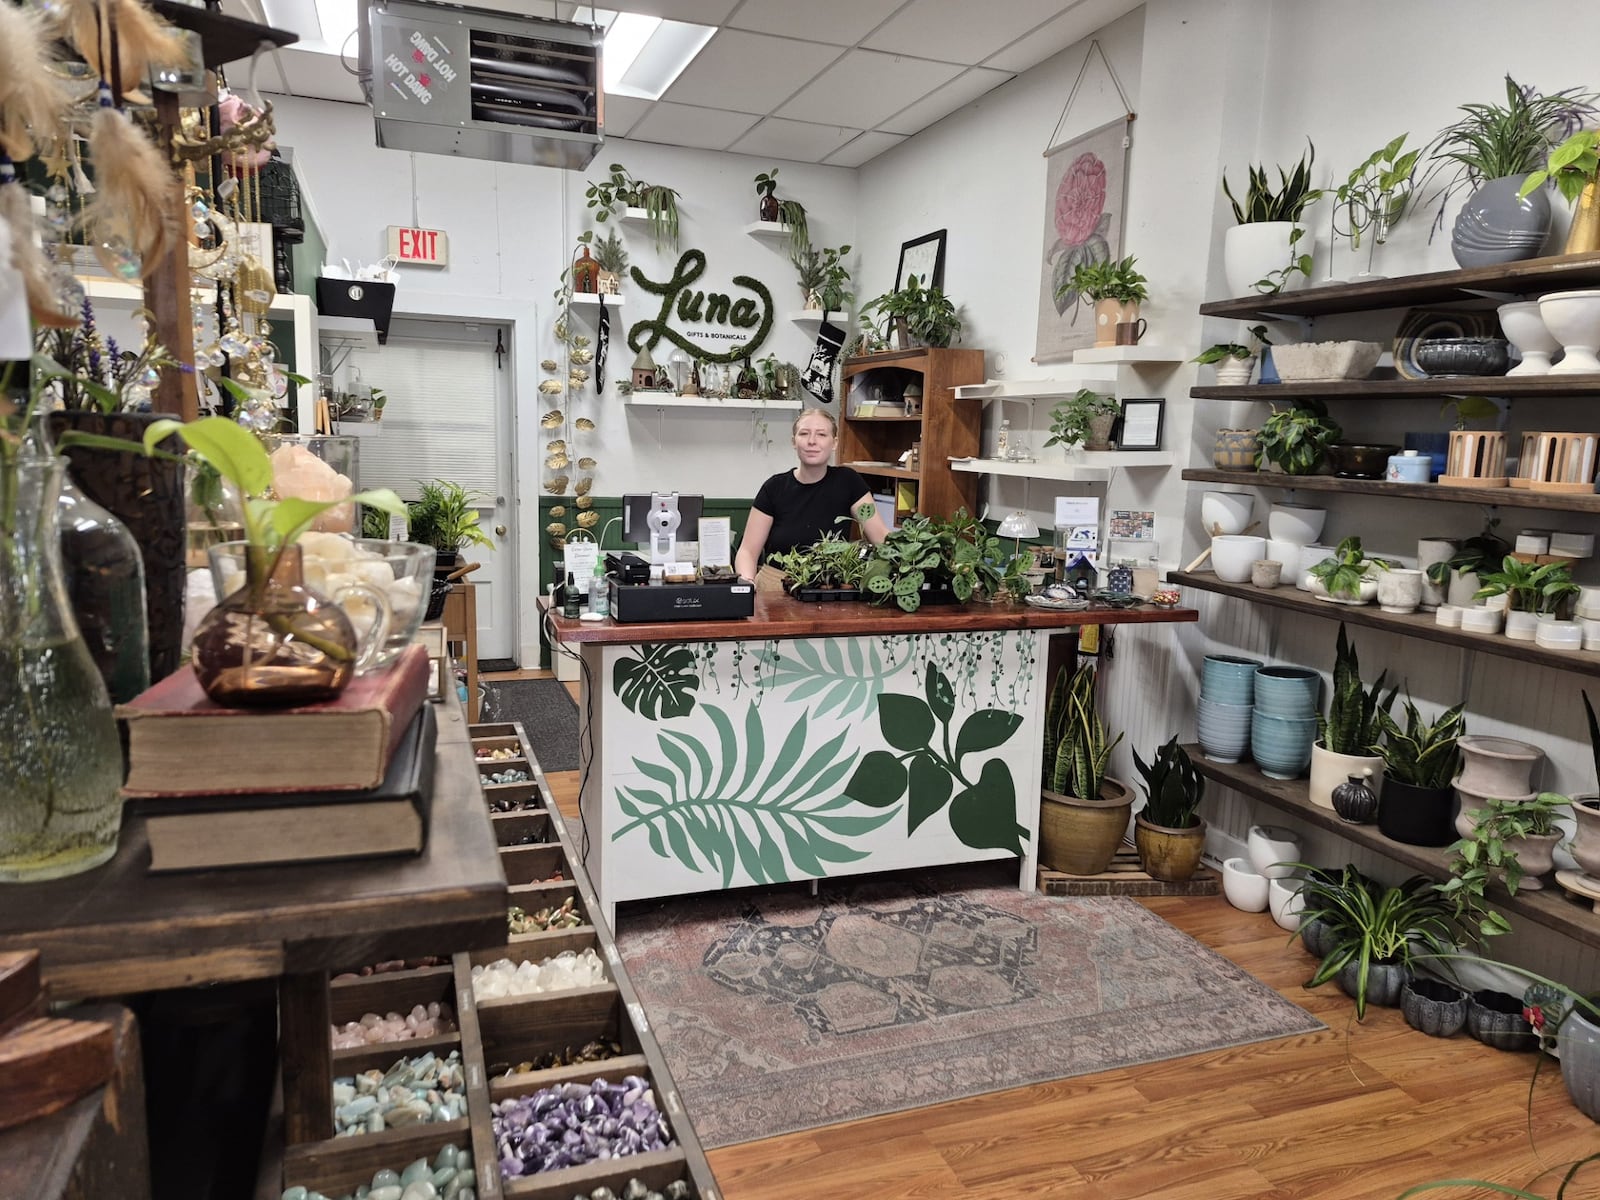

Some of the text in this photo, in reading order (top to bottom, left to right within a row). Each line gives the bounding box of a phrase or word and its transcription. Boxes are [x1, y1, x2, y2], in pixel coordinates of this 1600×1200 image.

[409, 31, 439, 63] DAWG
[384, 53, 409, 77] HOT
[403, 73, 432, 105] DAWG
[433, 59, 457, 83] HOT
[399, 228, 438, 261] EXIT
[627, 248, 774, 364] Luna
